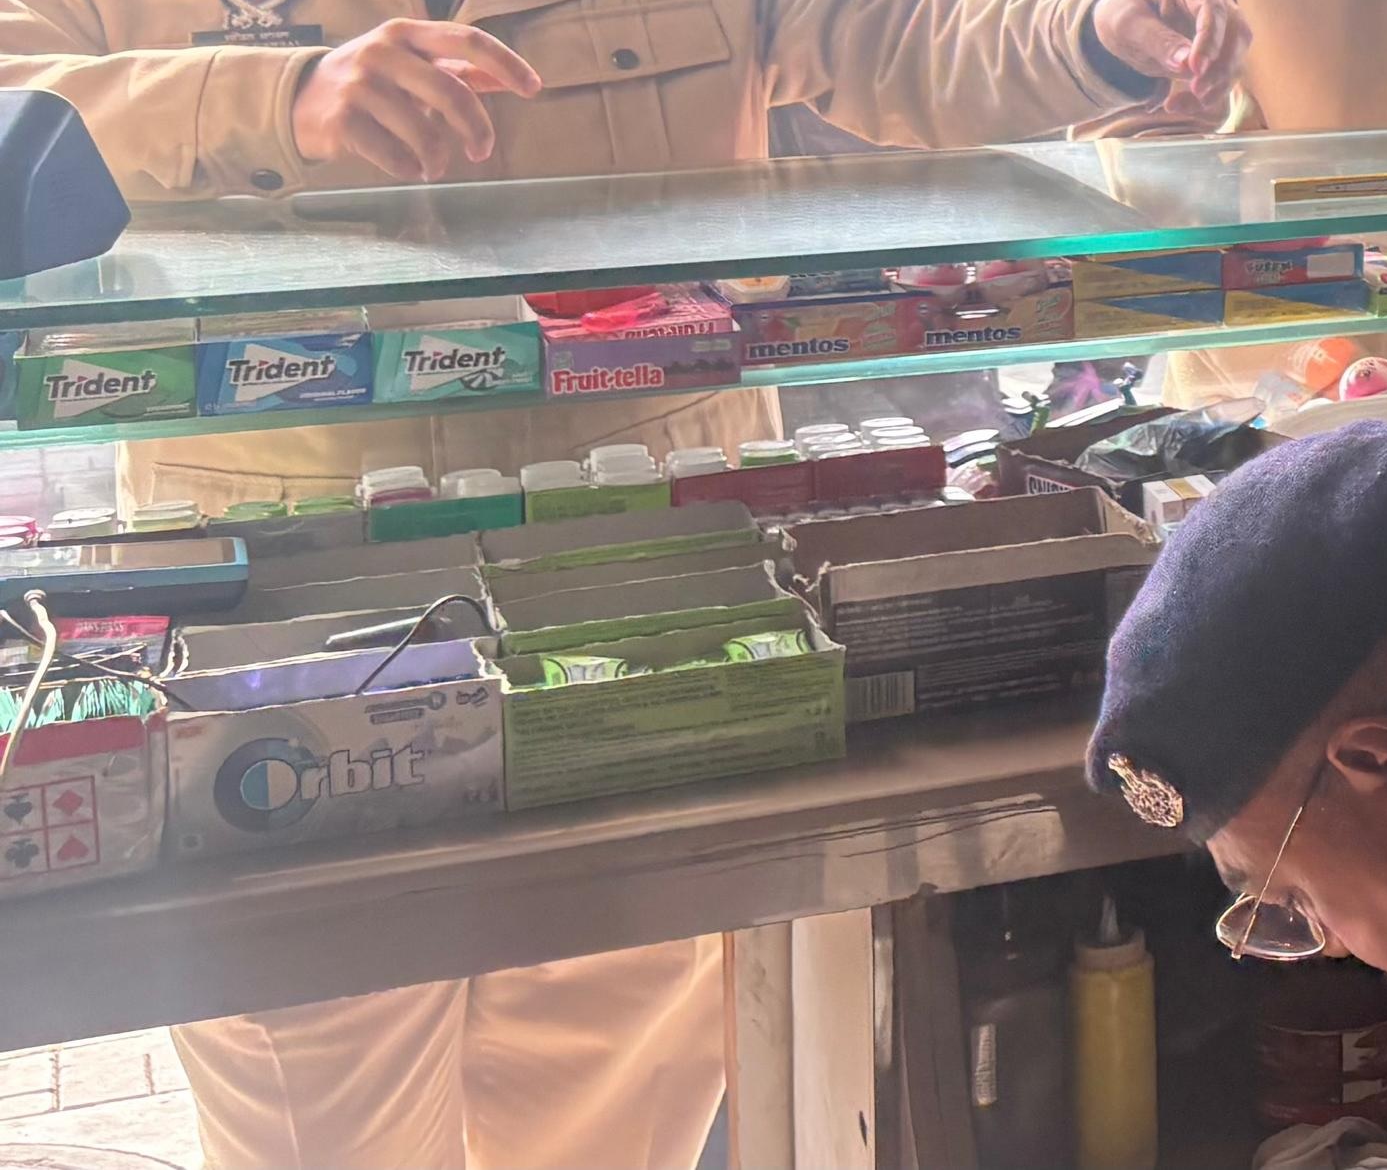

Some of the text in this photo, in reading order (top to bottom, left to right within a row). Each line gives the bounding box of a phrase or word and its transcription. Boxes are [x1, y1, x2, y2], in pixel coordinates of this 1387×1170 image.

[747, 337, 850, 361] mentos
[925, 324, 1022, 347] mentos
[227, 356, 336, 386] Trident
[404, 346, 506, 372] Trident
[46, 370, 156, 401] Trident
[214, 735, 426, 833] Orbit
